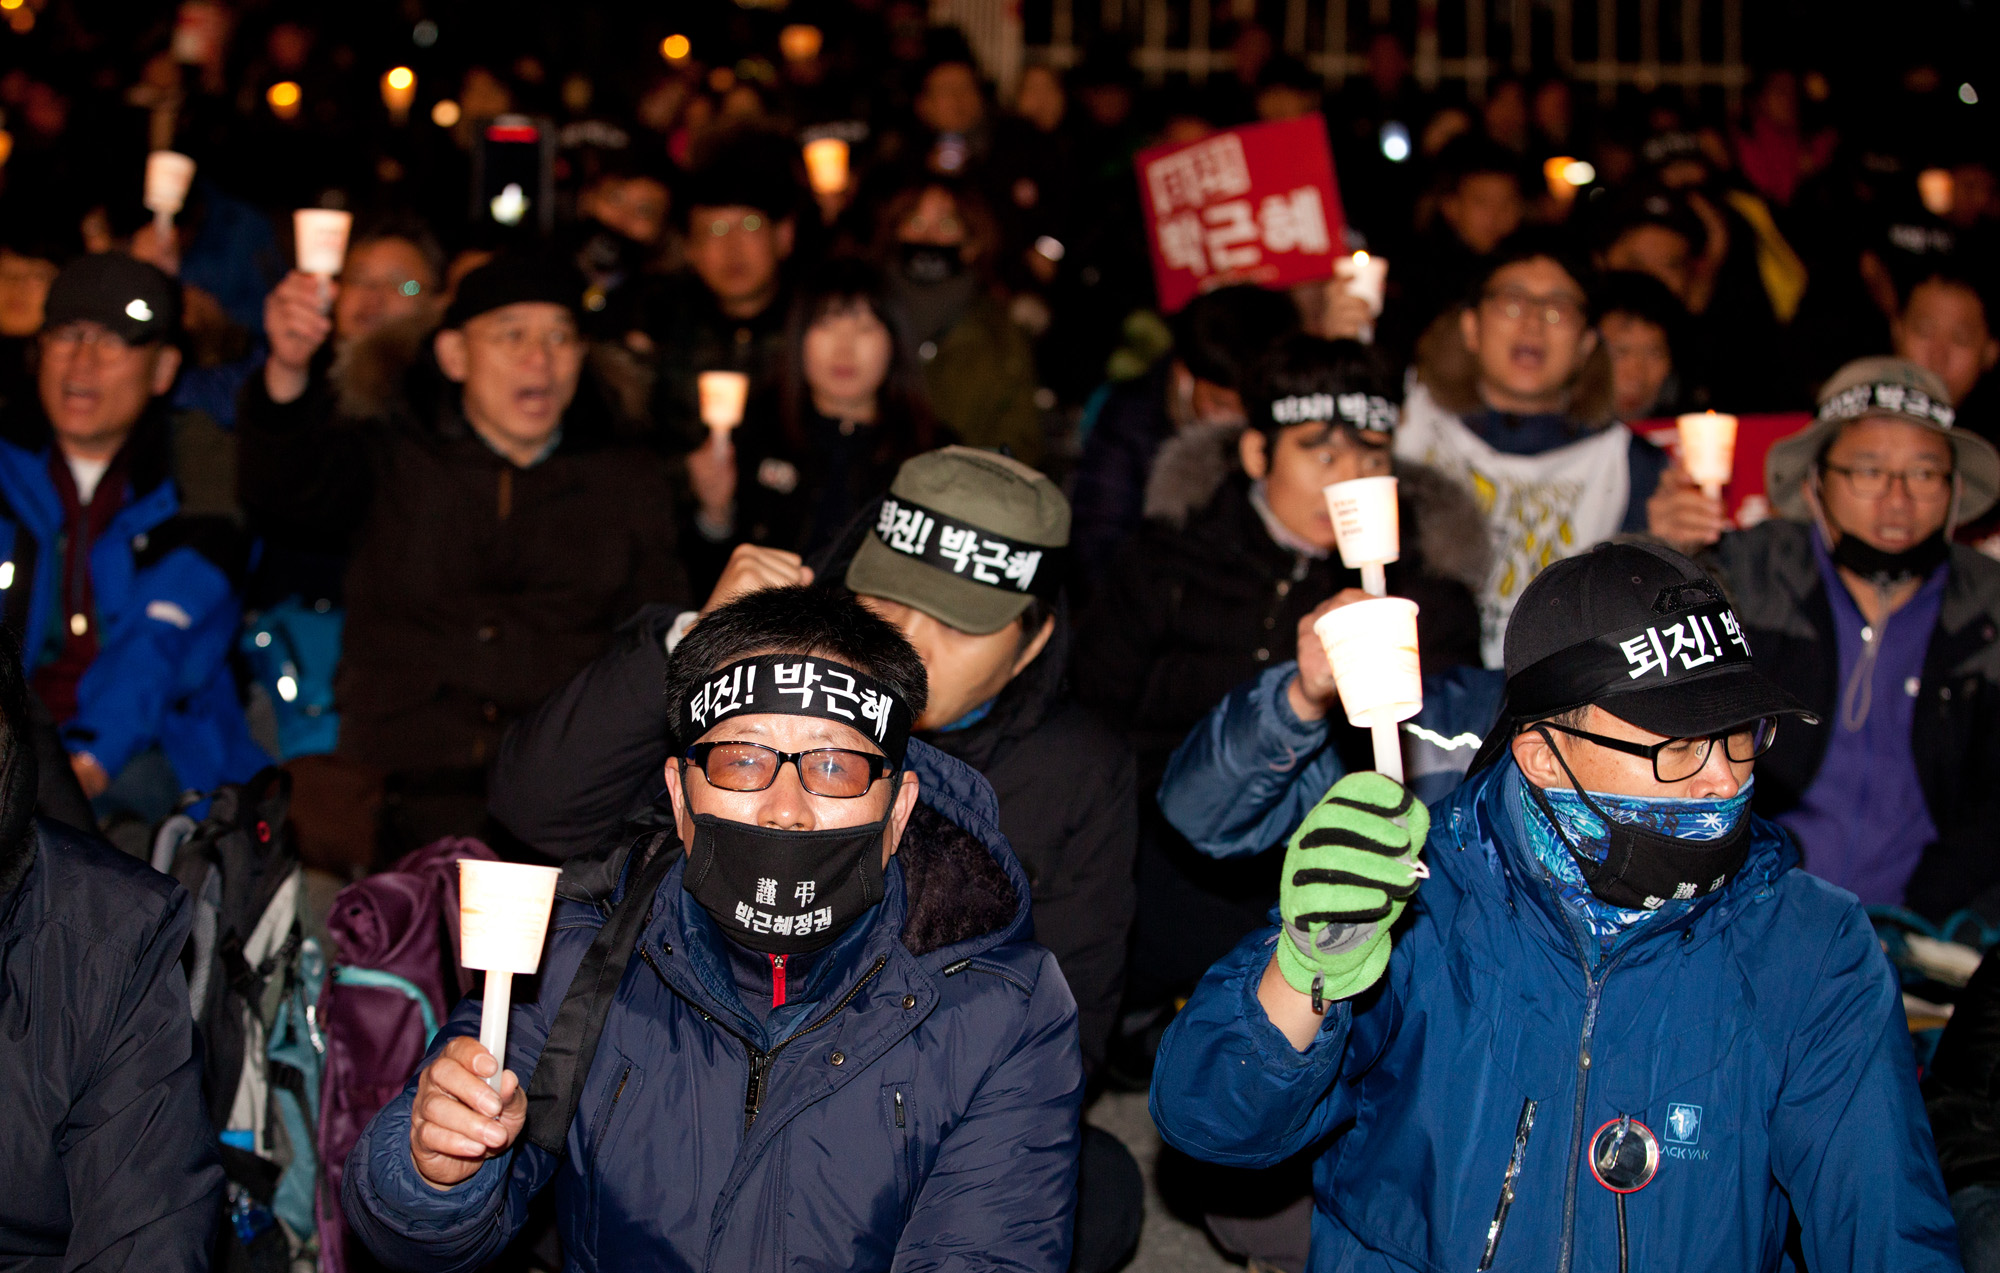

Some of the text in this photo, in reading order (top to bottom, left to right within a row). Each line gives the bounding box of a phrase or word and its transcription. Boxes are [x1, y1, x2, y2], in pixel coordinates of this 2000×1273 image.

[1155, 184, 1331, 278] 박근혜
[876, 500, 1043, 592] 퇴진! 박근혜
[1618, 608, 1753, 680] 퇴진! 박
[690, 661, 893, 743] 퇴진! 박근혜
[734, 900, 833, 937] 박근혜정권
